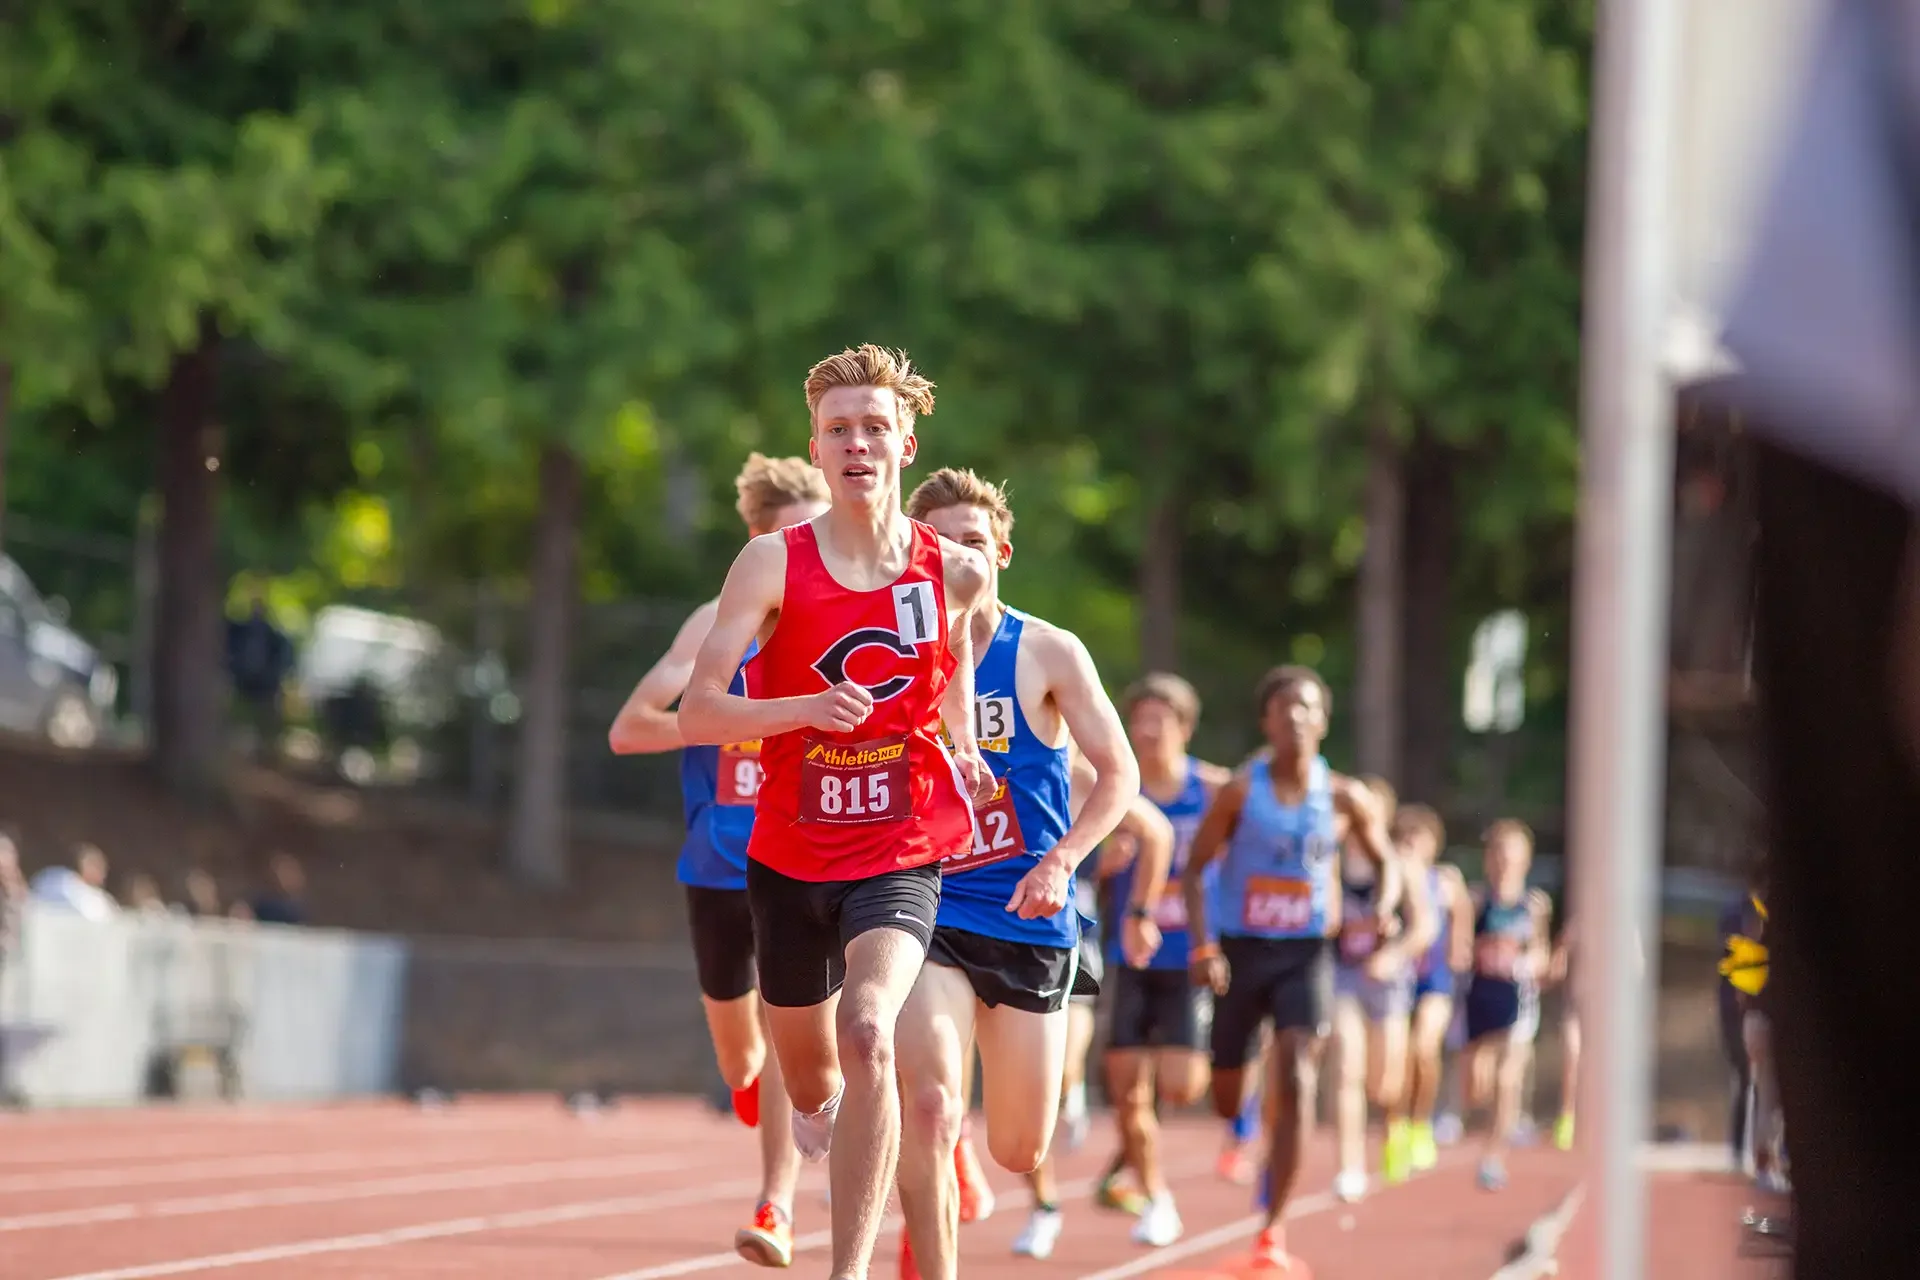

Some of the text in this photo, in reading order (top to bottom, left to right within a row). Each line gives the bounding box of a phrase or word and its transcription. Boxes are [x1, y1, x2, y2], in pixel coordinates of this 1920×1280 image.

[901, 586, 926, 639] 1
[809, 627, 919, 702] C
[820, 771, 890, 815] 815
